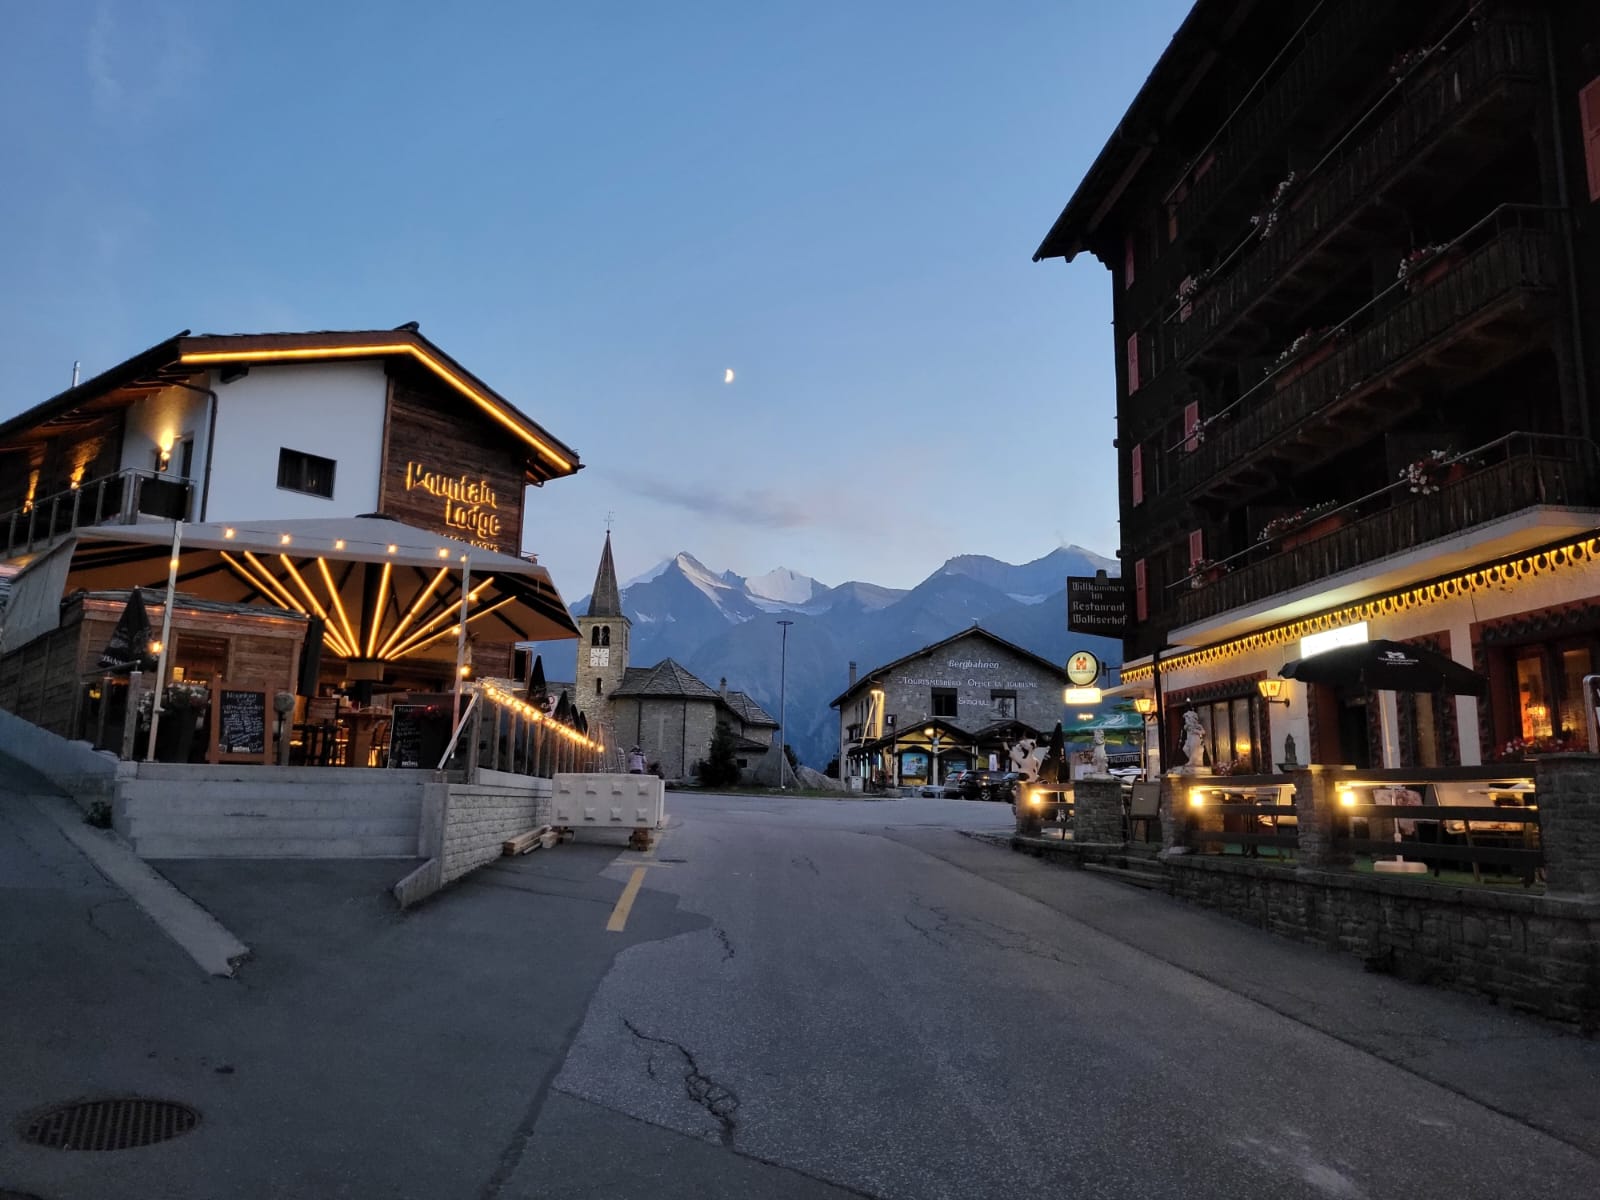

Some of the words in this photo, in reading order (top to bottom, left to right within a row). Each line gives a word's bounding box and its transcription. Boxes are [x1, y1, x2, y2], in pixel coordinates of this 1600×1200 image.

[445, 499, 501, 539] Lodge
[1073, 600, 1125, 611] Restaurant
[1073, 613, 1128, 625] Walliserhof
[948, 658, 1000, 670] Bergbahnen
